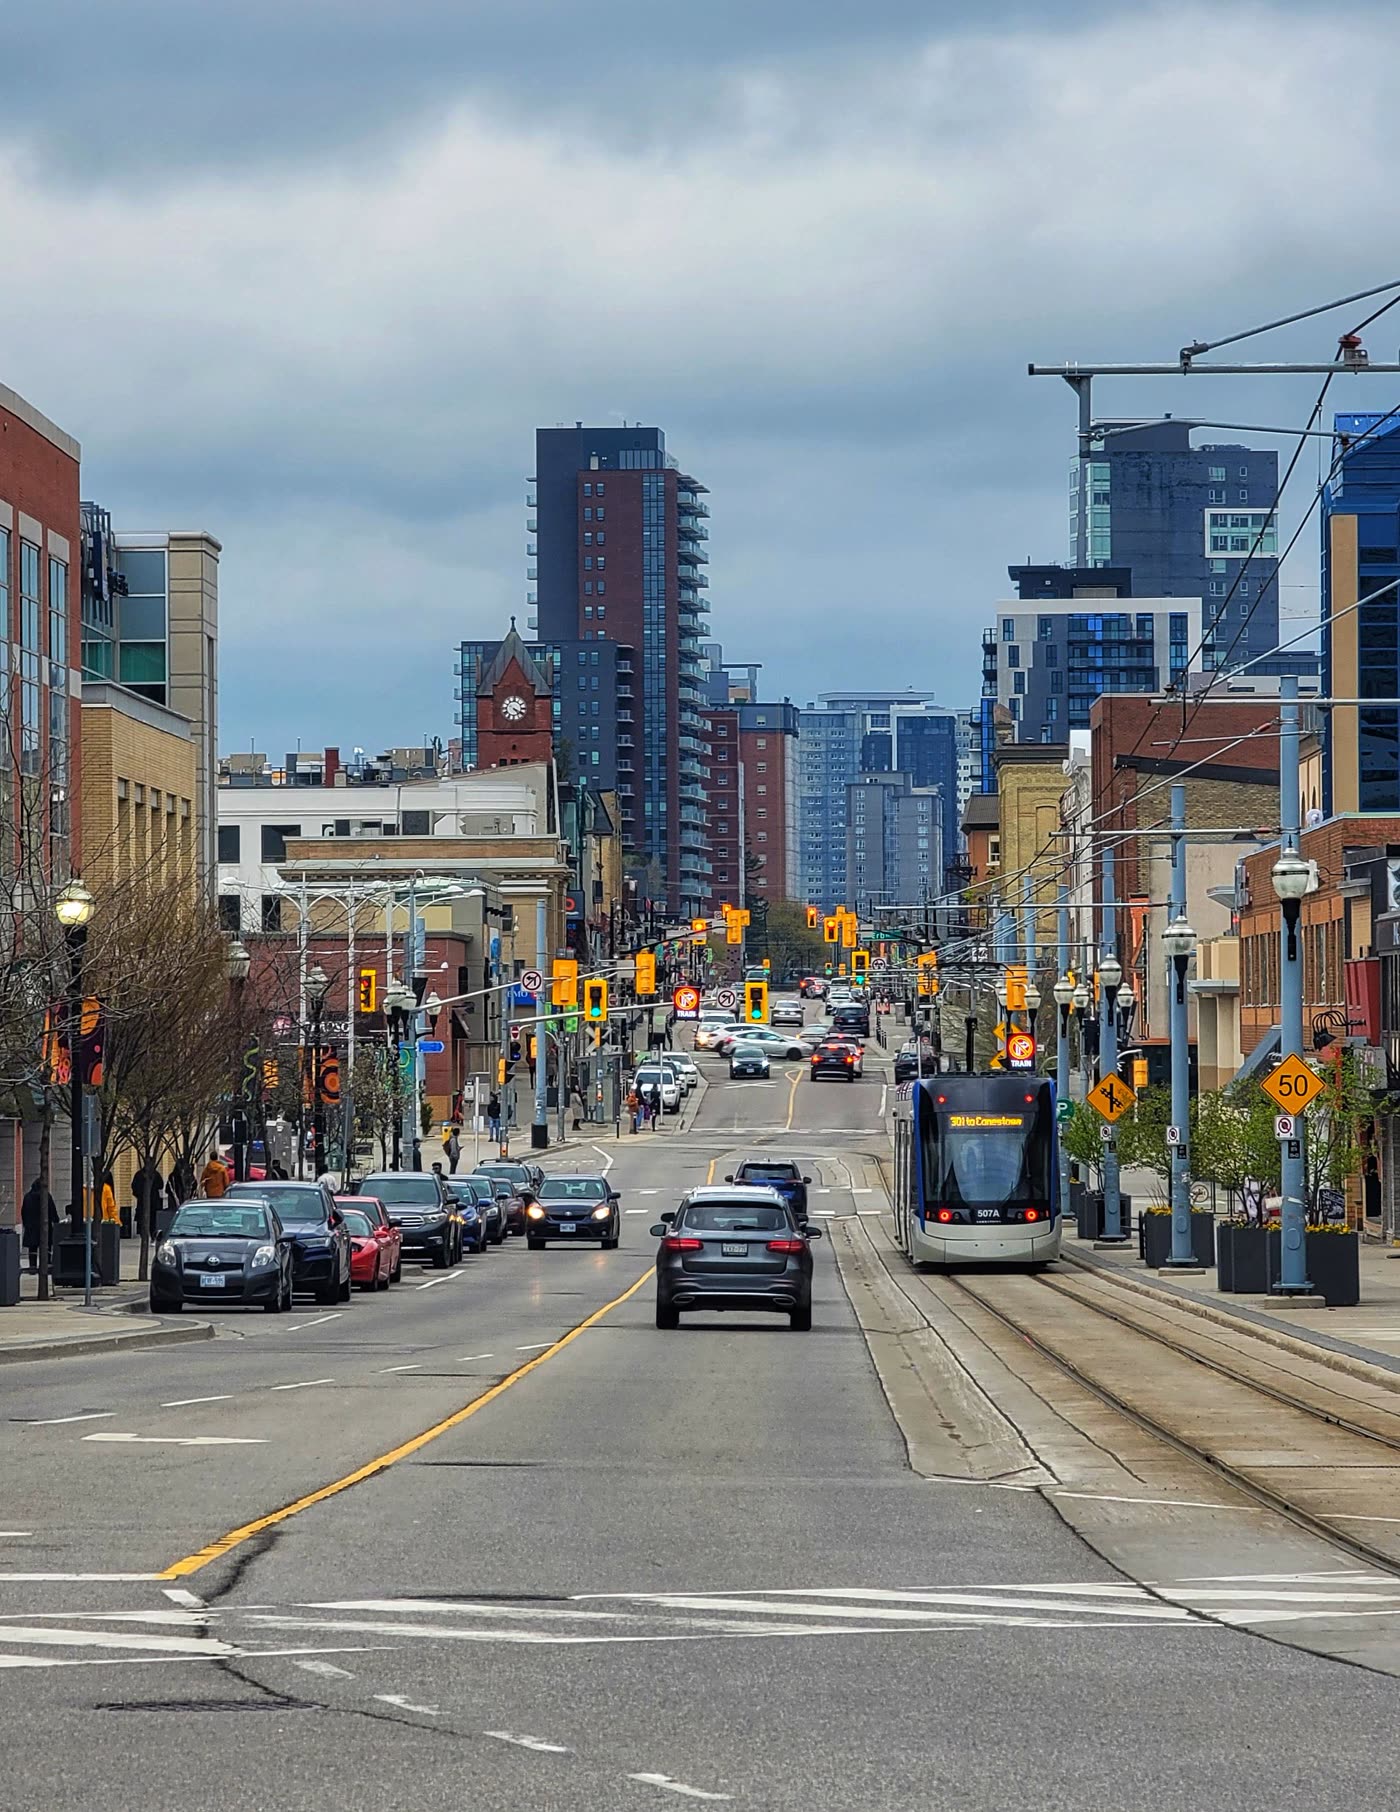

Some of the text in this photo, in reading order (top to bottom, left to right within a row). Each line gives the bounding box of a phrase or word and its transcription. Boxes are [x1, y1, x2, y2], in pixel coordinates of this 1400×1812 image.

[676, 1010, 697, 1018] TRAIN
[1011, 1059, 1032, 1067] TRAIN
[1278, 1074, 1308, 1097] 50
[950, 1116, 965, 1126] 301
[966, 1116, 975, 1126] to
[977, 1209, 1000, 1218] 507A
